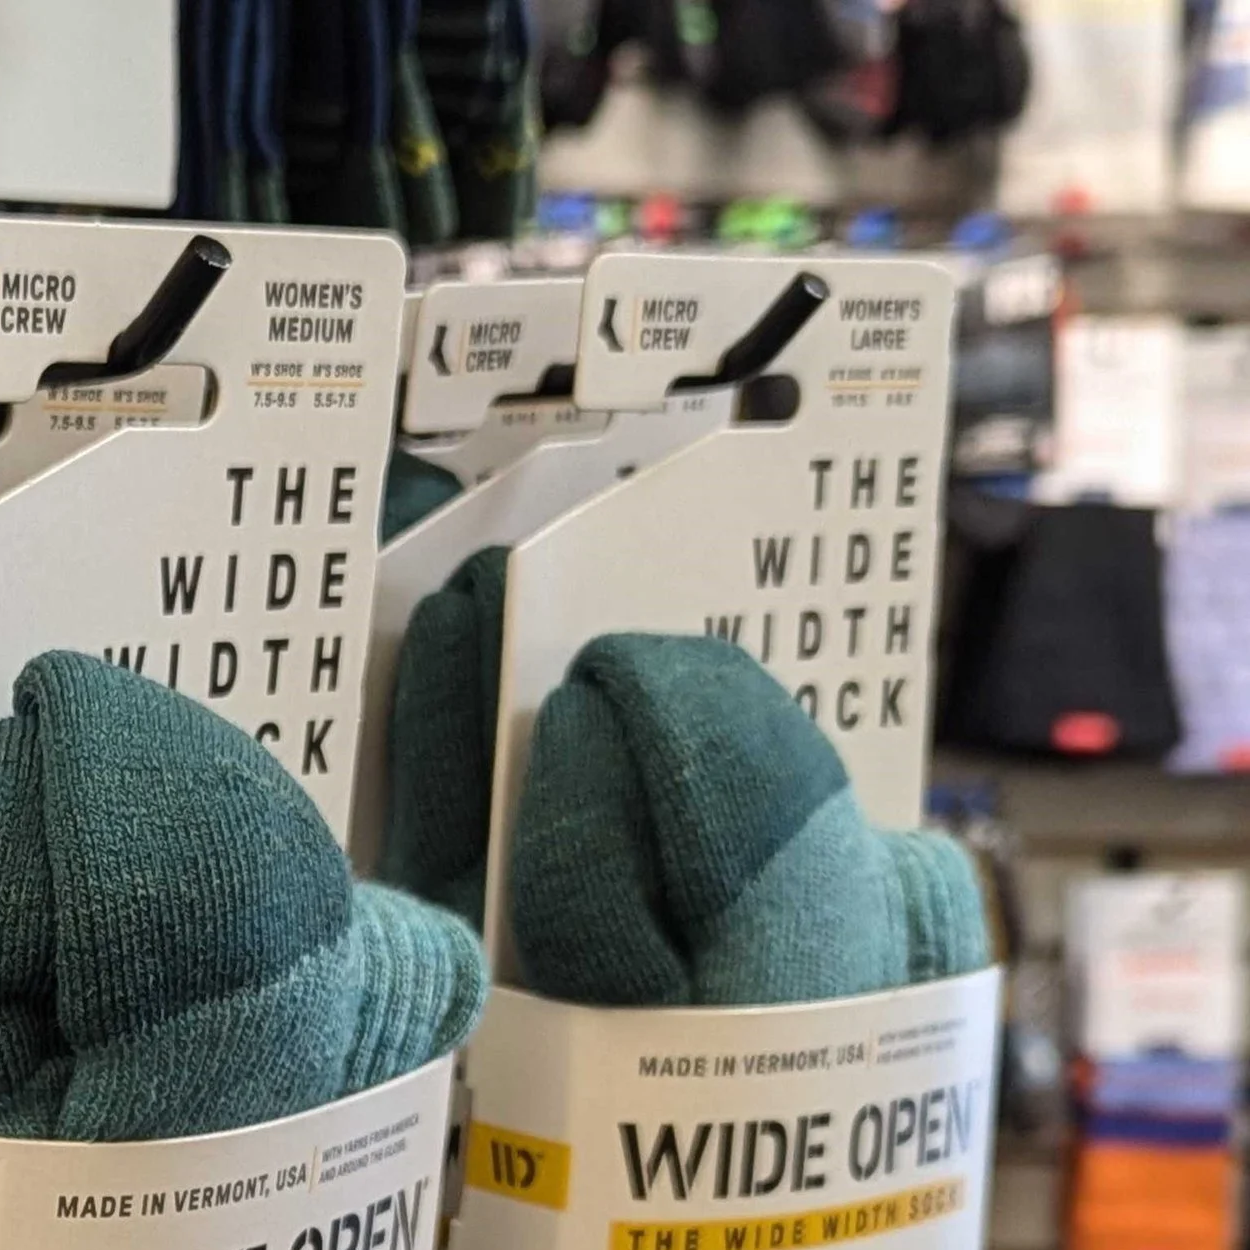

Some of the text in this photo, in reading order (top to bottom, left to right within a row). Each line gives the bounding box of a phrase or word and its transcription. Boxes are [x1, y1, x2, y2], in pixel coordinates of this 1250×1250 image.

[2, 273, 75, 302] MICRO
[265, 282, 362, 309] WOMEN'S
[1, 307, 66, 335] CREW
[642, 300, 698, 322] MICRO
[840, 299, 921, 321] WOMEN'S
[268, 316, 353, 343] MEDIUM
[469, 322, 521, 345] MICRO
[639, 328, 690, 351] CREW
[851, 328, 905, 351] LARGE
[274, 363, 303, 378] SHOE
[335, 364, 363, 379] SHOE
[466, 349, 512, 373] CREW
[254, 392, 296, 408] 7.5-9.5
[227, 467, 356, 526] THE
[809, 457, 918, 510] THE
[753, 531, 913, 589] WIDE
[160, 552, 347, 616] WIDE
[638, 1055, 706, 1077] MADE
[714, 1055, 736, 1077] IN
[836, 1043, 865, 1066] USA
[618, 1112, 830, 1201] WIDE
[57, 1162, 307, 1218] MADE IN VERMONT, USA
[821, 1204, 898, 1241] WIDTH
